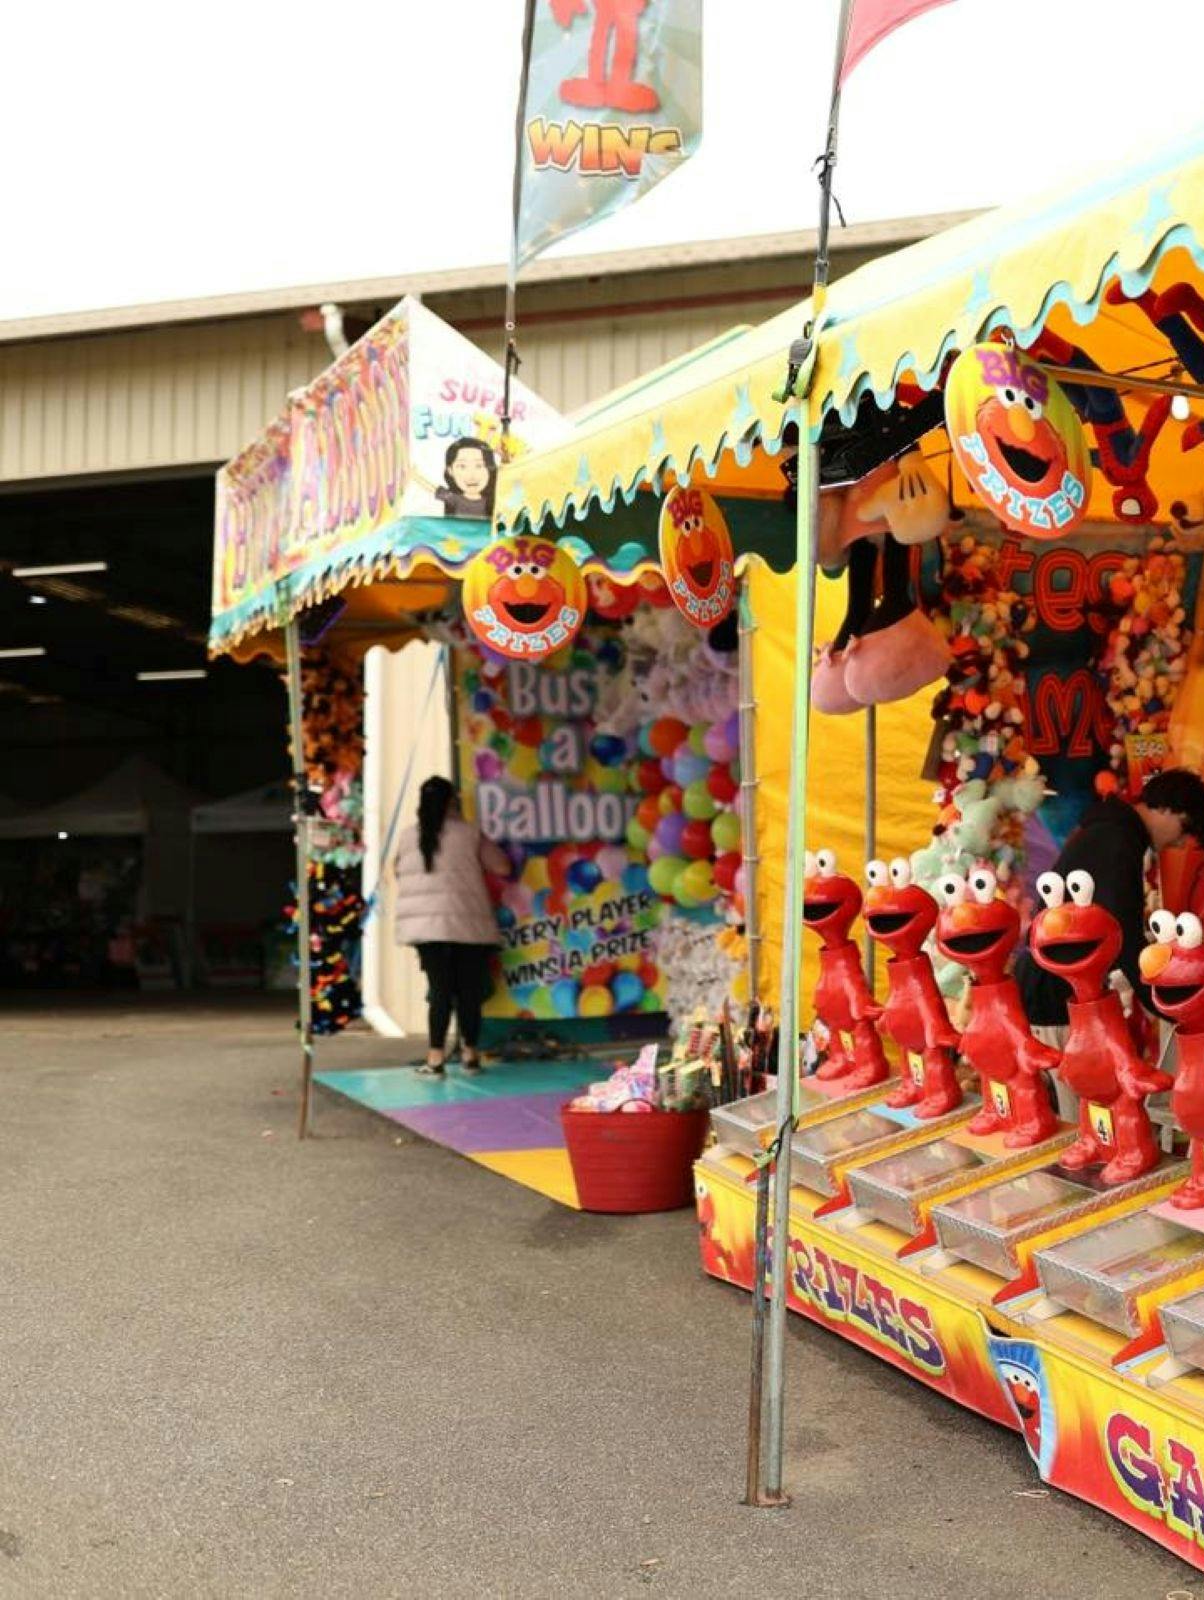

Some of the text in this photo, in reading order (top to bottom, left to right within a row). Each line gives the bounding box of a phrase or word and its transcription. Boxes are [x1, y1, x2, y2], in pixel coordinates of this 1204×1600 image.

[440, 378, 528, 422] SUPER
[976, 350, 1050, 407] BIG
[412, 403, 473, 440] FUN
[958, 432, 1085, 530] PRIZES
[668, 490, 705, 528] BIG
[486, 538, 556, 574] BIG
[674, 560, 732, 621] PRIZES
[474, 604, 580, 653] PRIZES
[551, 726, 580, 772] a
[570, 895, 650, 930] PLAYER
[505, 929, 651, 988] WINS A PRIZE
[1096, 1116, 1109, 1143] 4
